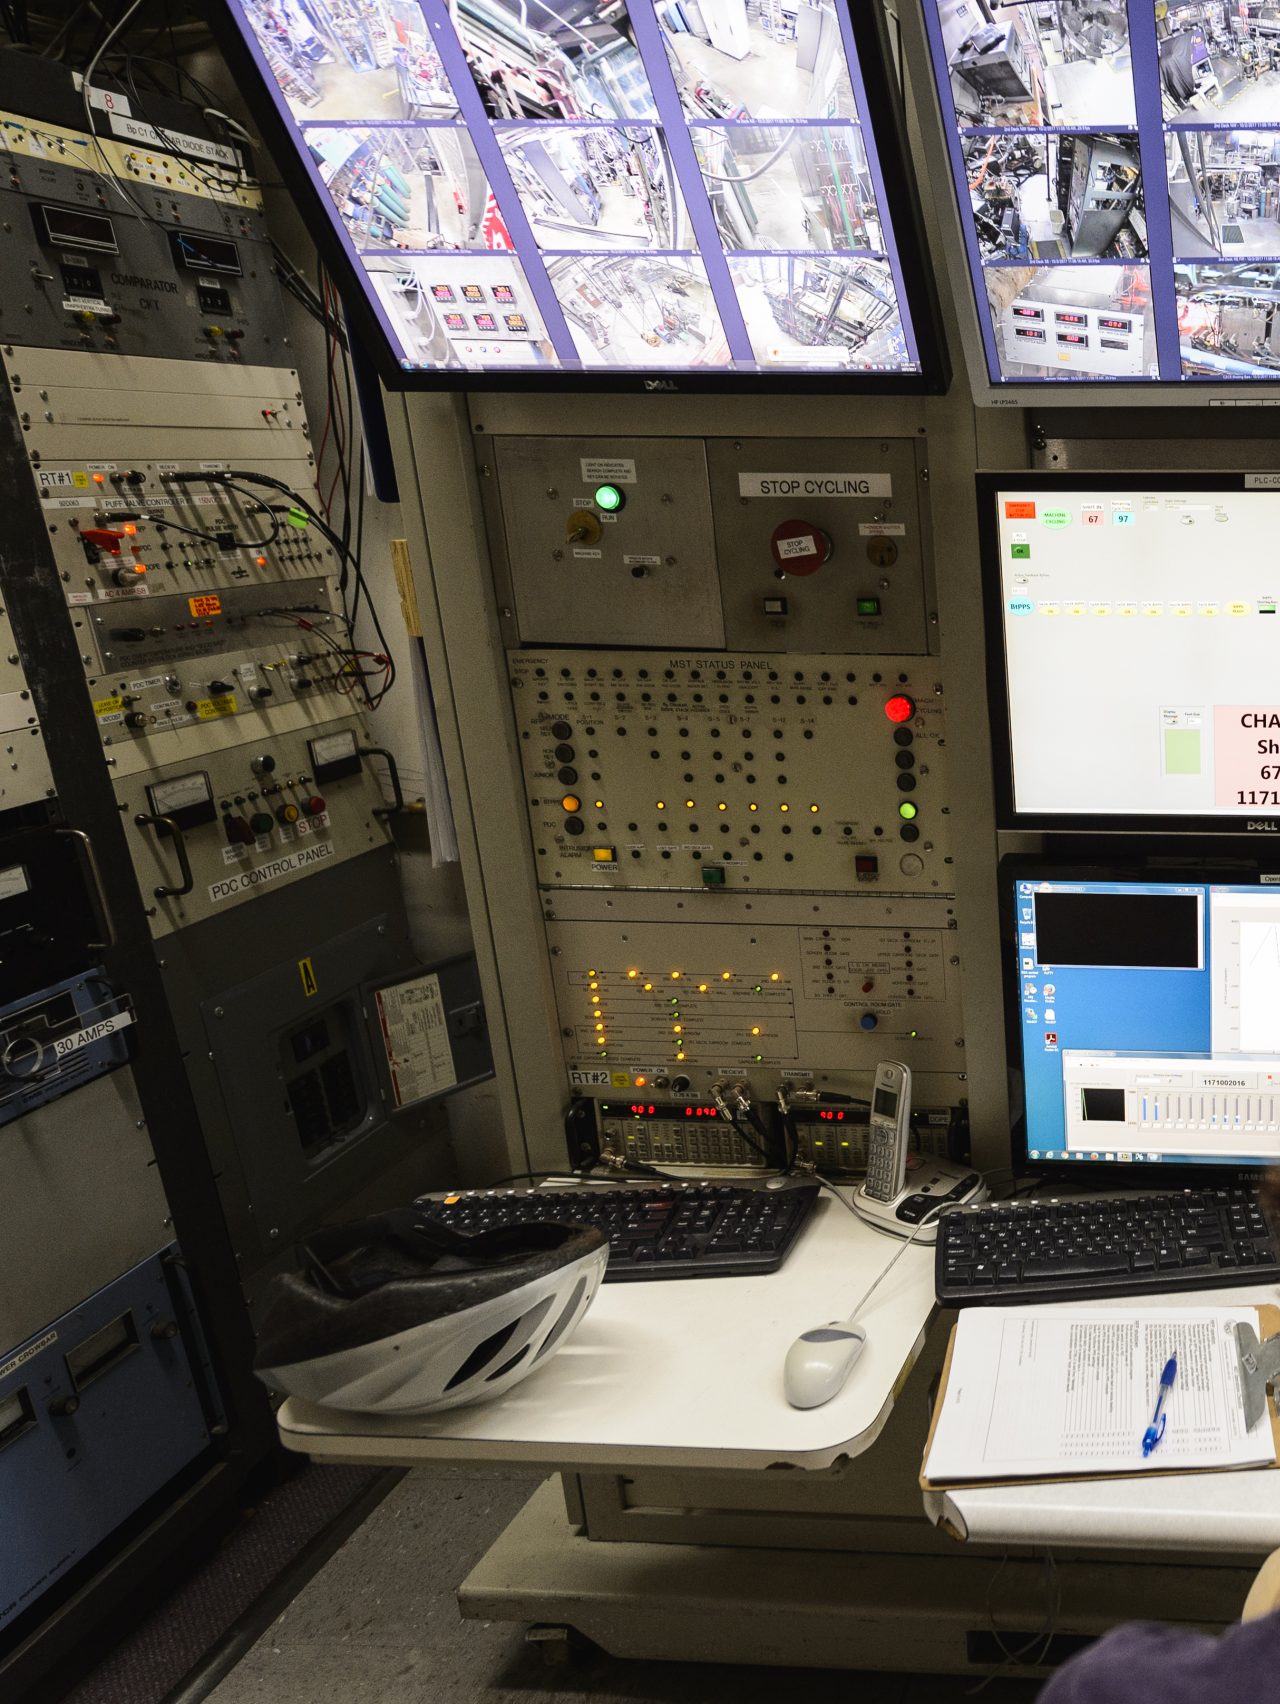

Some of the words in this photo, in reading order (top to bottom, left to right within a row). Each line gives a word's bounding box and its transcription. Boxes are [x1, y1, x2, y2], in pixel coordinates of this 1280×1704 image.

[104, 94, 114, 109] 8
[182, 140, 205, 153] DIODE
[206, 145, 229, 160] STACK
[110, 272, 179, 294] COMPARATOR
[643, 381, 678, 390] DELL
[40, 472, 72, 485] RT#1
[760, 481, 800, 494] STOP
[804, 481, 870, 494] CYCLING
[1088, 515, 1099, 523] 67
[1118, 515, 1129, 523] 97
[786, 540, 804, 548] STOP
[783, 546, 811, 556] CYCLING
[1010, 603, 1031, 611] BtPPS
[669, 660, 691, 669] MST
[696, 660, 735, 670] STATUS
[740, 661, 773, 670] PANEL
[550, 713, 570, 721] MODE
[299, 814, 327, 834] STOP
[1247, 821, 1278, 831] DELL
[211, 878, 239, 899] PDC
[240, 858, 297, 889] CONTROL
[297, 844, 334, 865] PANEL
[591, 863, 618, 871] POWER
[57, 1038, 73, 1054] 30
[77, 1020, 115, 1047] AMPS
[571, 1072, 609, 1084] RT#2
[1203, 1079, 1246, 1087] 1171002016
[18, 1332, 57, 1363] CROWBAR
